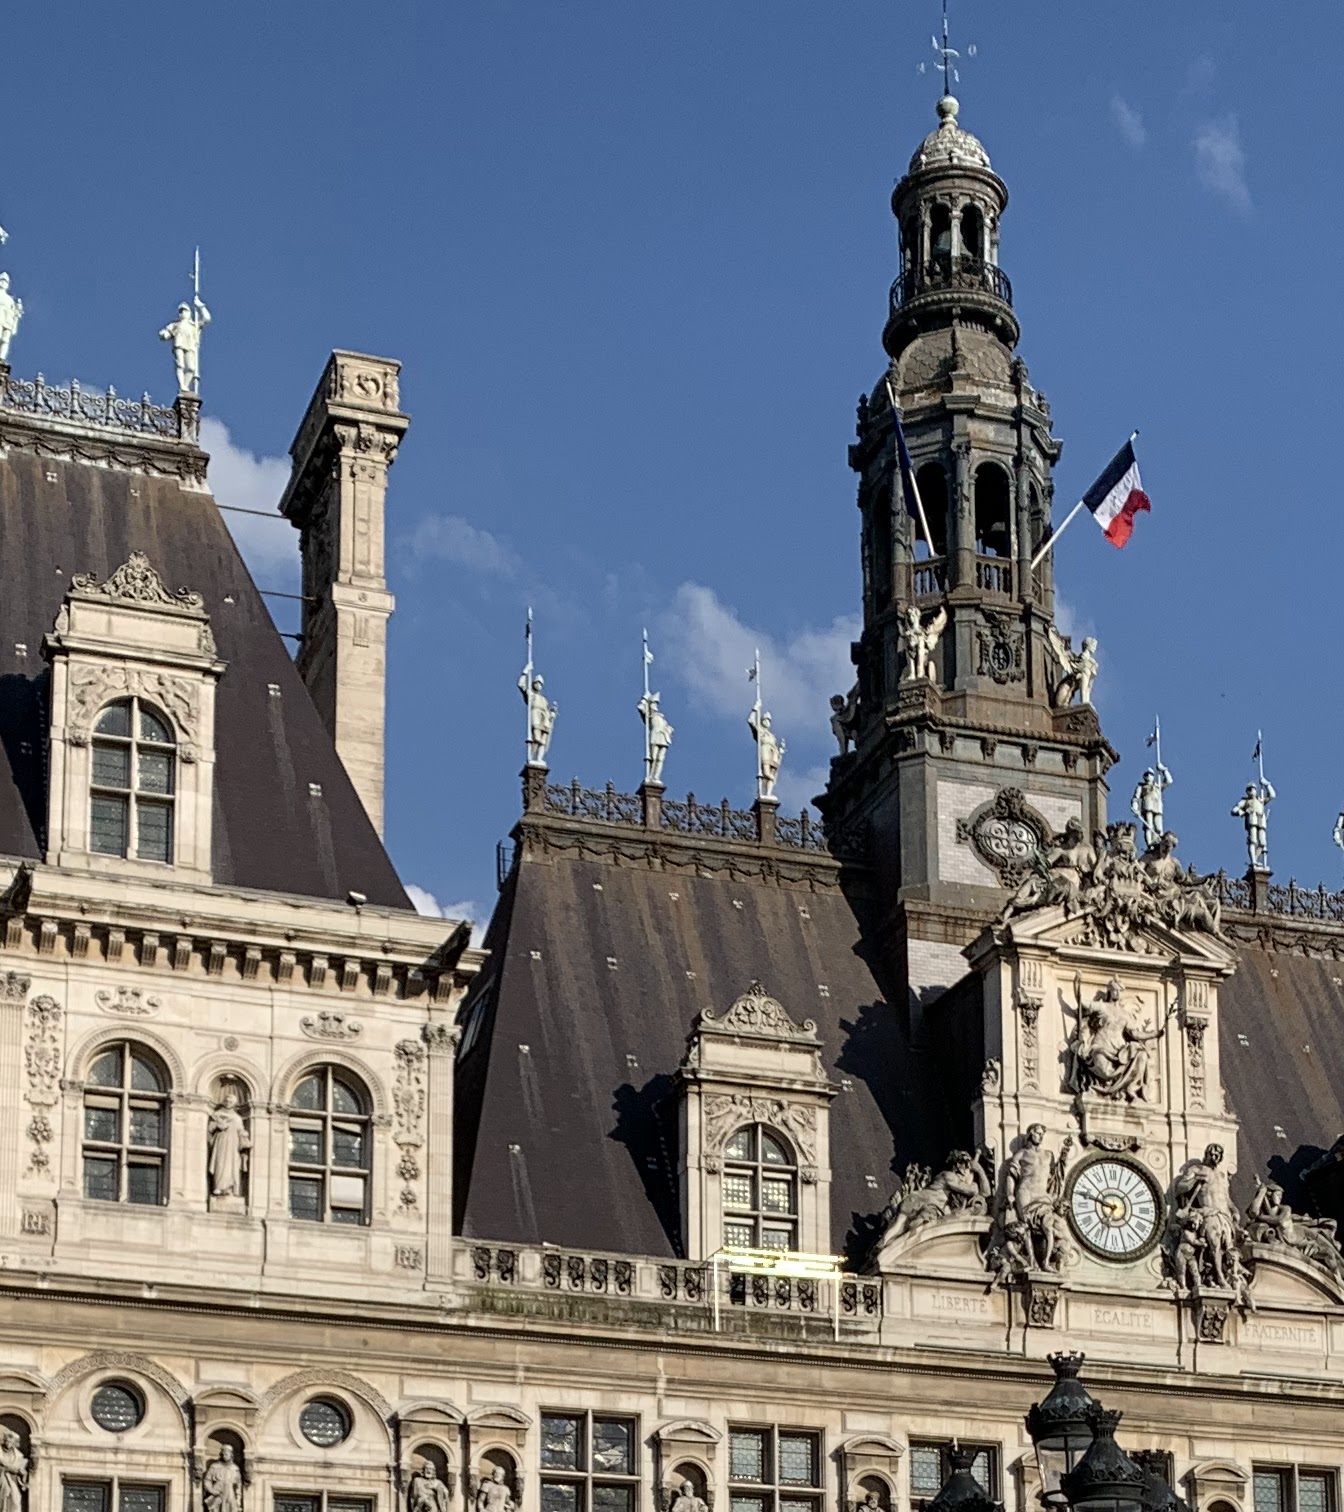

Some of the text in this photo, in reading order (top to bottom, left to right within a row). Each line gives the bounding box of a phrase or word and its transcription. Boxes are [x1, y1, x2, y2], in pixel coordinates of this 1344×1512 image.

[932, 1293, 987, 1313] LIBERTÉ
[1094, 1308, 1151, 1329] ÉGALITÉ
[1244, 1323, 1317, 1343] FRATERNITÉ
